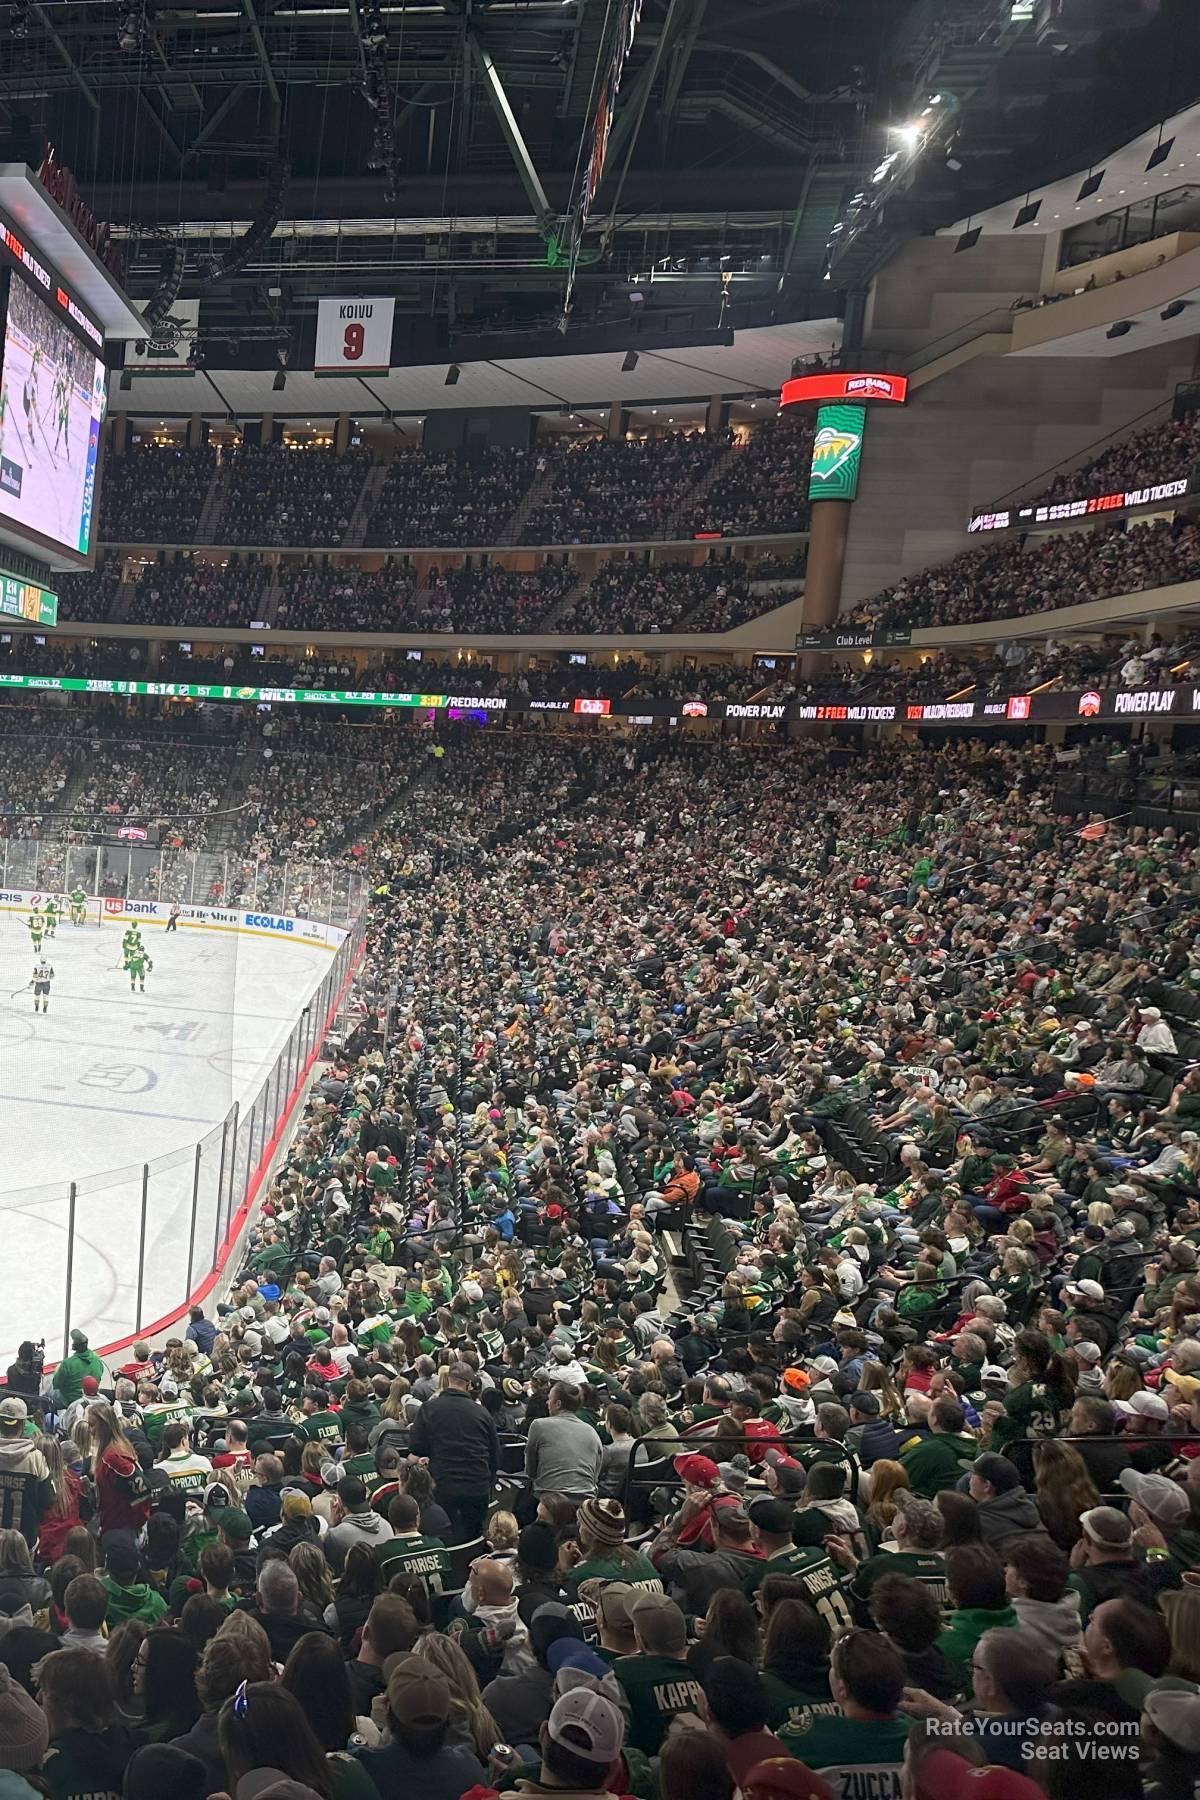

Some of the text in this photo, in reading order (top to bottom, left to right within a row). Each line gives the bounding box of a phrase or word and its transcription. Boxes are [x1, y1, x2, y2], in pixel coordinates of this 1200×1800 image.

[340, 305, 373, 319] KOIVU
[343, 323, 365, 360] 9
[1088, 500, 1096, 513] 2
[1098, 494, 1124, 510] FREE
[1125, 490, 1149, 506] WILD
[1151, 479, 1188, 501] TICKETS!
[836, 634, 872, 646] Club Level
[147, 683, 175, 696] 6:14
[197, 686, 211, 696] 1ST
[259, 691, 296, 702] WILD
[530, 701, 569, 710] AVAILABLE AT
[1115, 692, 1147, 712] POWER
[1148, 690, 1175, 711] PLAY
[726, 705, 785, 718] POWER PLAY
[800, 706, 895, 720] WIN 2 FREE WILD TICKETS!
[907, 706, 923, 719] VISIT
[106, 902, 122, 911] us
[125, 902, 157, 914] bank
[246, 914, 294, 932] ECOLAB
[404, 1555, 442, 1575] PARISE
